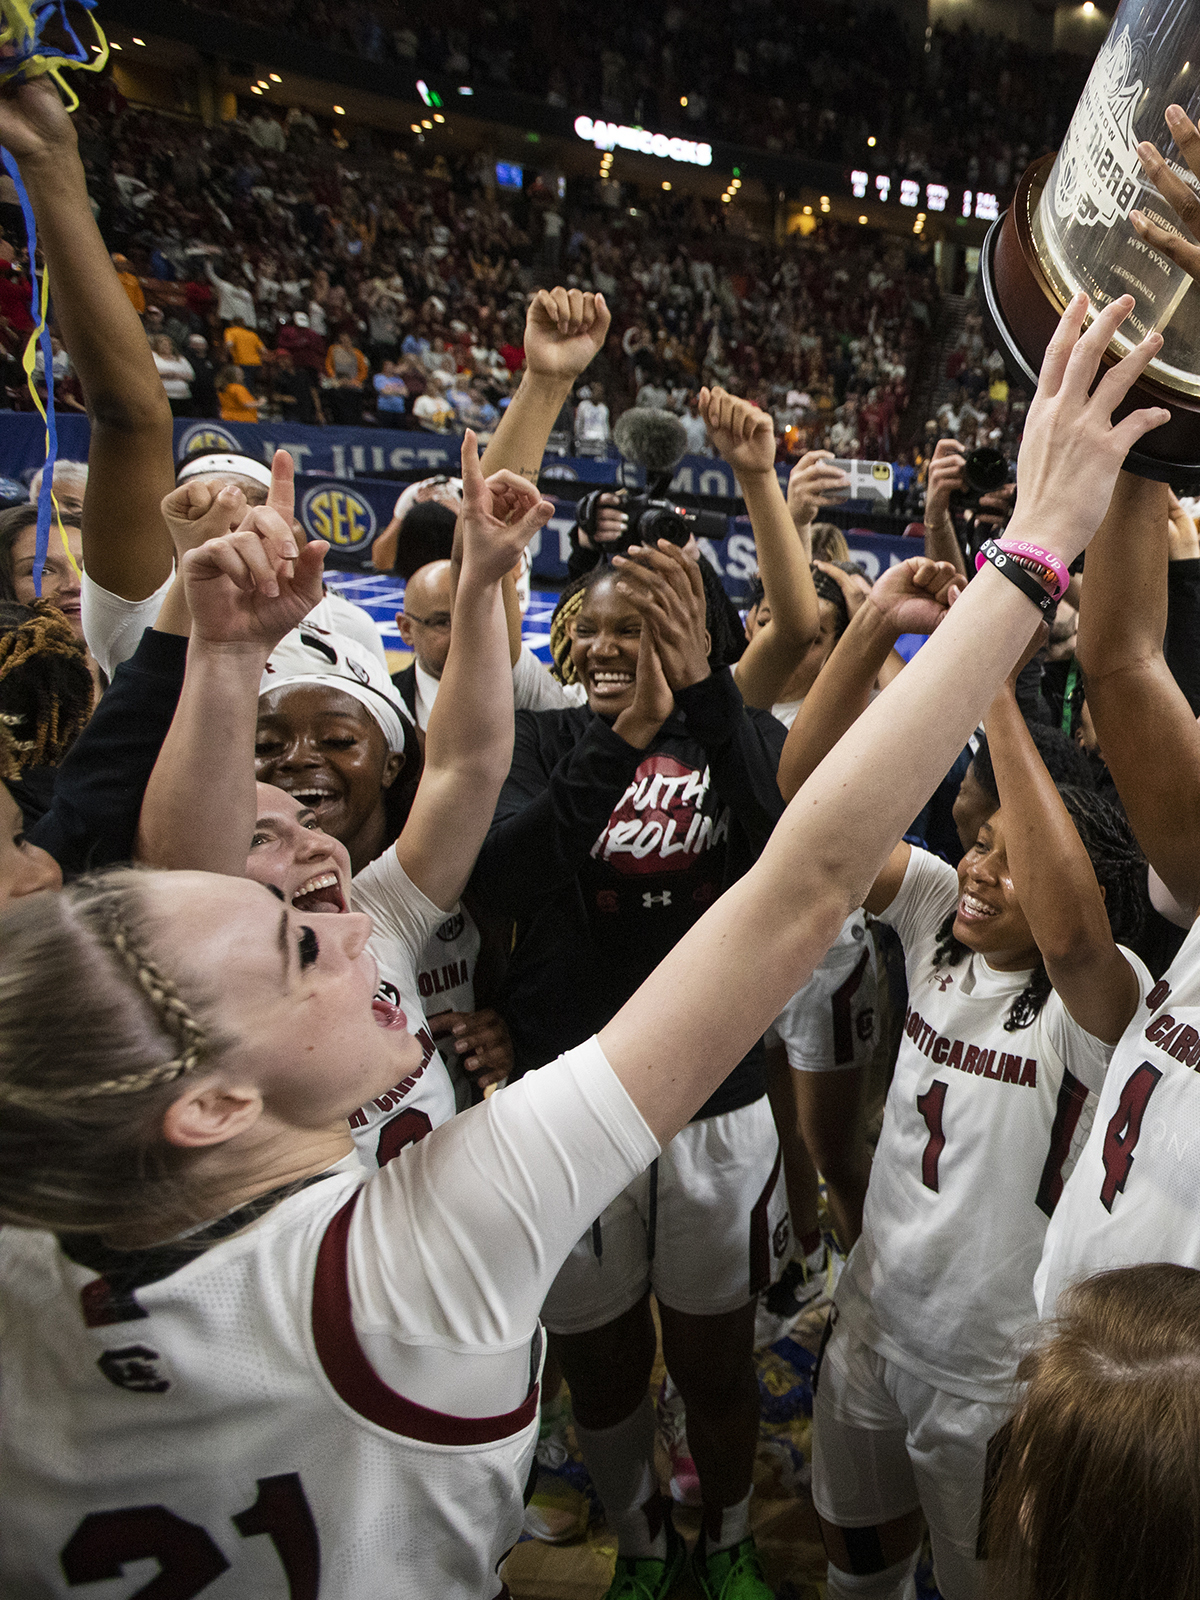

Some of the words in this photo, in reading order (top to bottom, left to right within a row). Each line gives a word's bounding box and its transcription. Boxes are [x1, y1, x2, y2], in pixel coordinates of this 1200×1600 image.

[310, 491, 366, 545] SEC
[1018, 541, 1044, 557] Give
[1045, 553, 1061, 570] Up
[614, 764, 711, 812] UTH
[419, 959, 469, 998] OLINA
[931, 1036, 1037, 1088] CAROLINA
[916, 1079, 949, 1194] 1
[1100, 1060, 1163, 1214] 4
